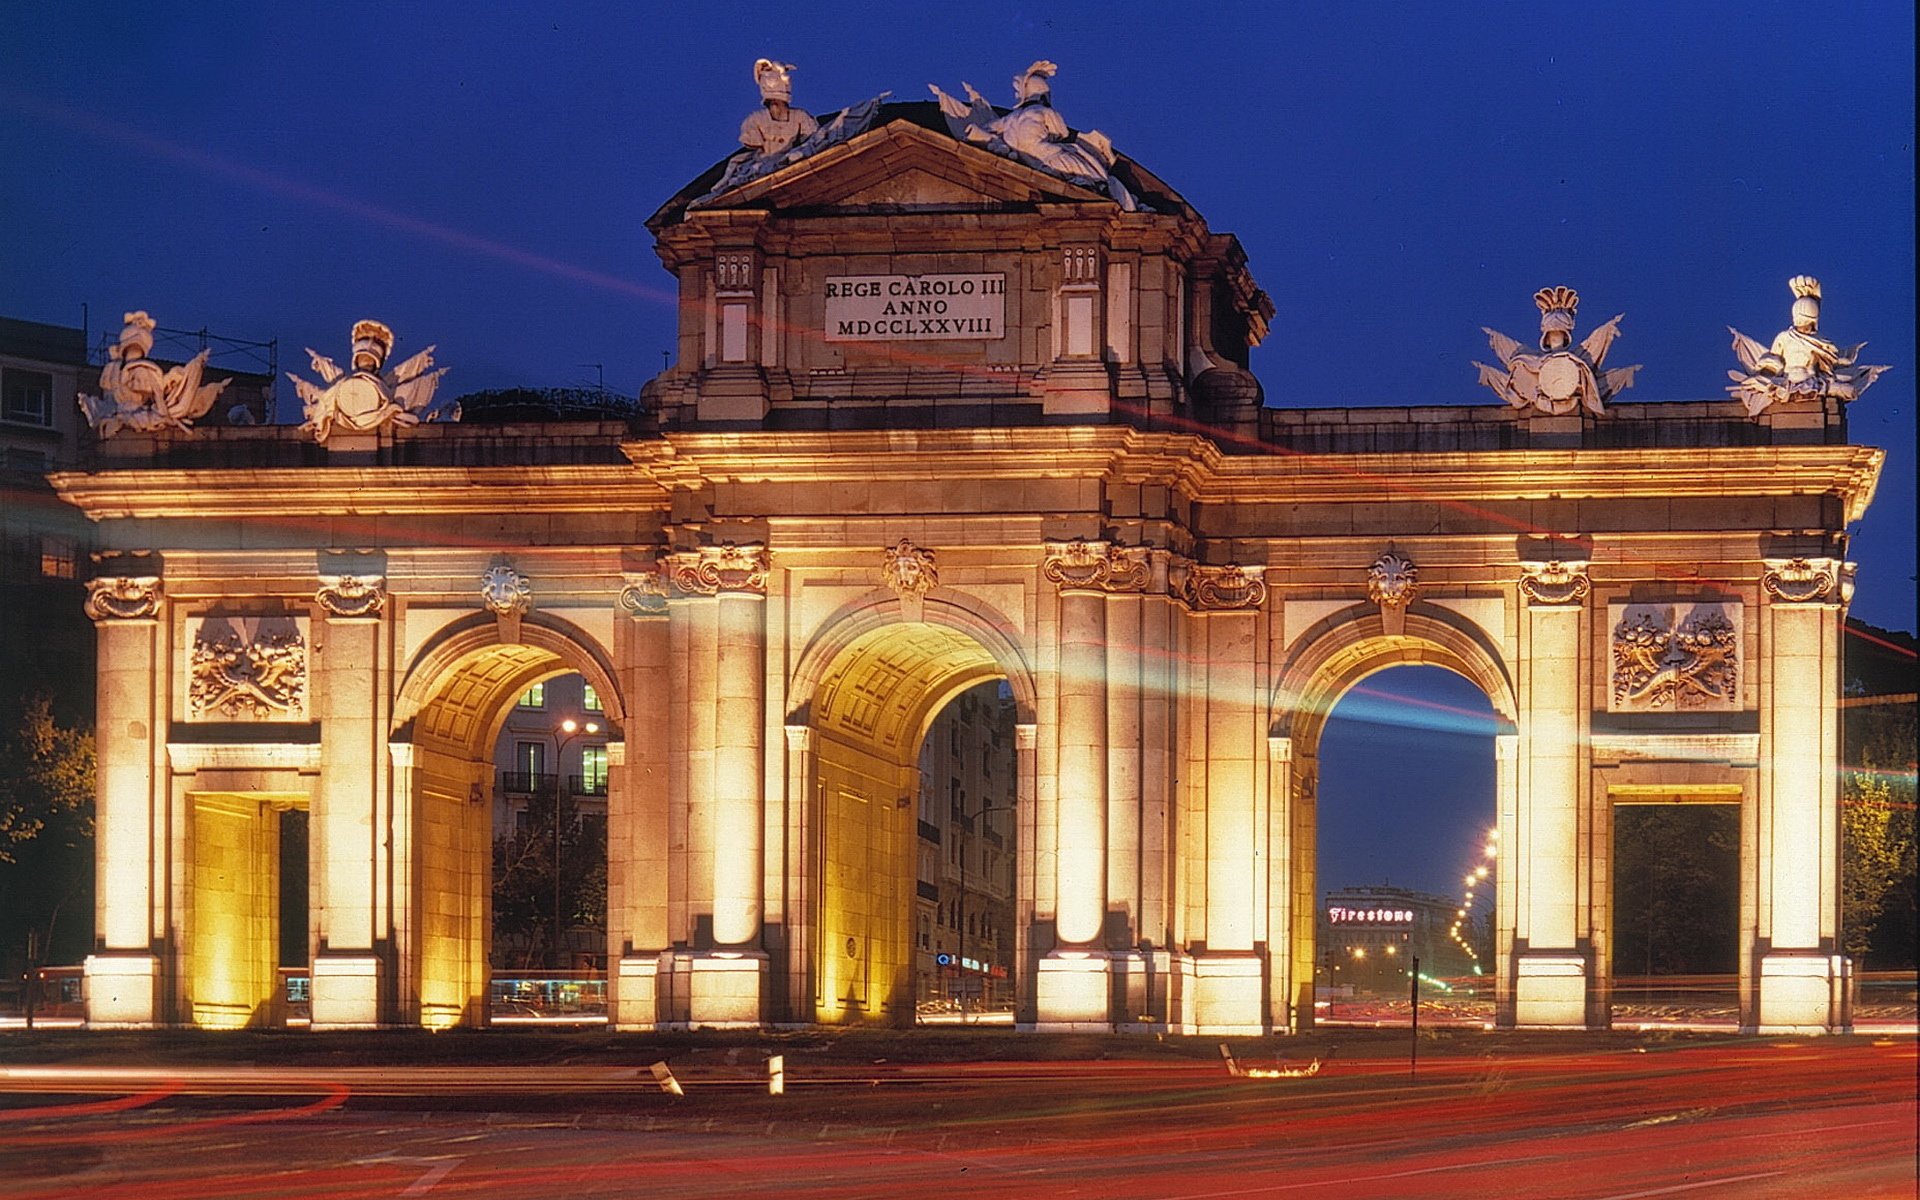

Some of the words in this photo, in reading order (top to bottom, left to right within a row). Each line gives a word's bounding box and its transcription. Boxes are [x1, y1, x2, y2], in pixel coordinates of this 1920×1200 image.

[826, 282, 882, 298] REGE
[888, 280, 975, 296] CAROLO
[981, 279, 1004, 295] III
[882, 300, 948, 315] ANNO
[837, 318, 992, 335] MDCCLXXVIII
[1329, 907, 1413, 923] Firestone
